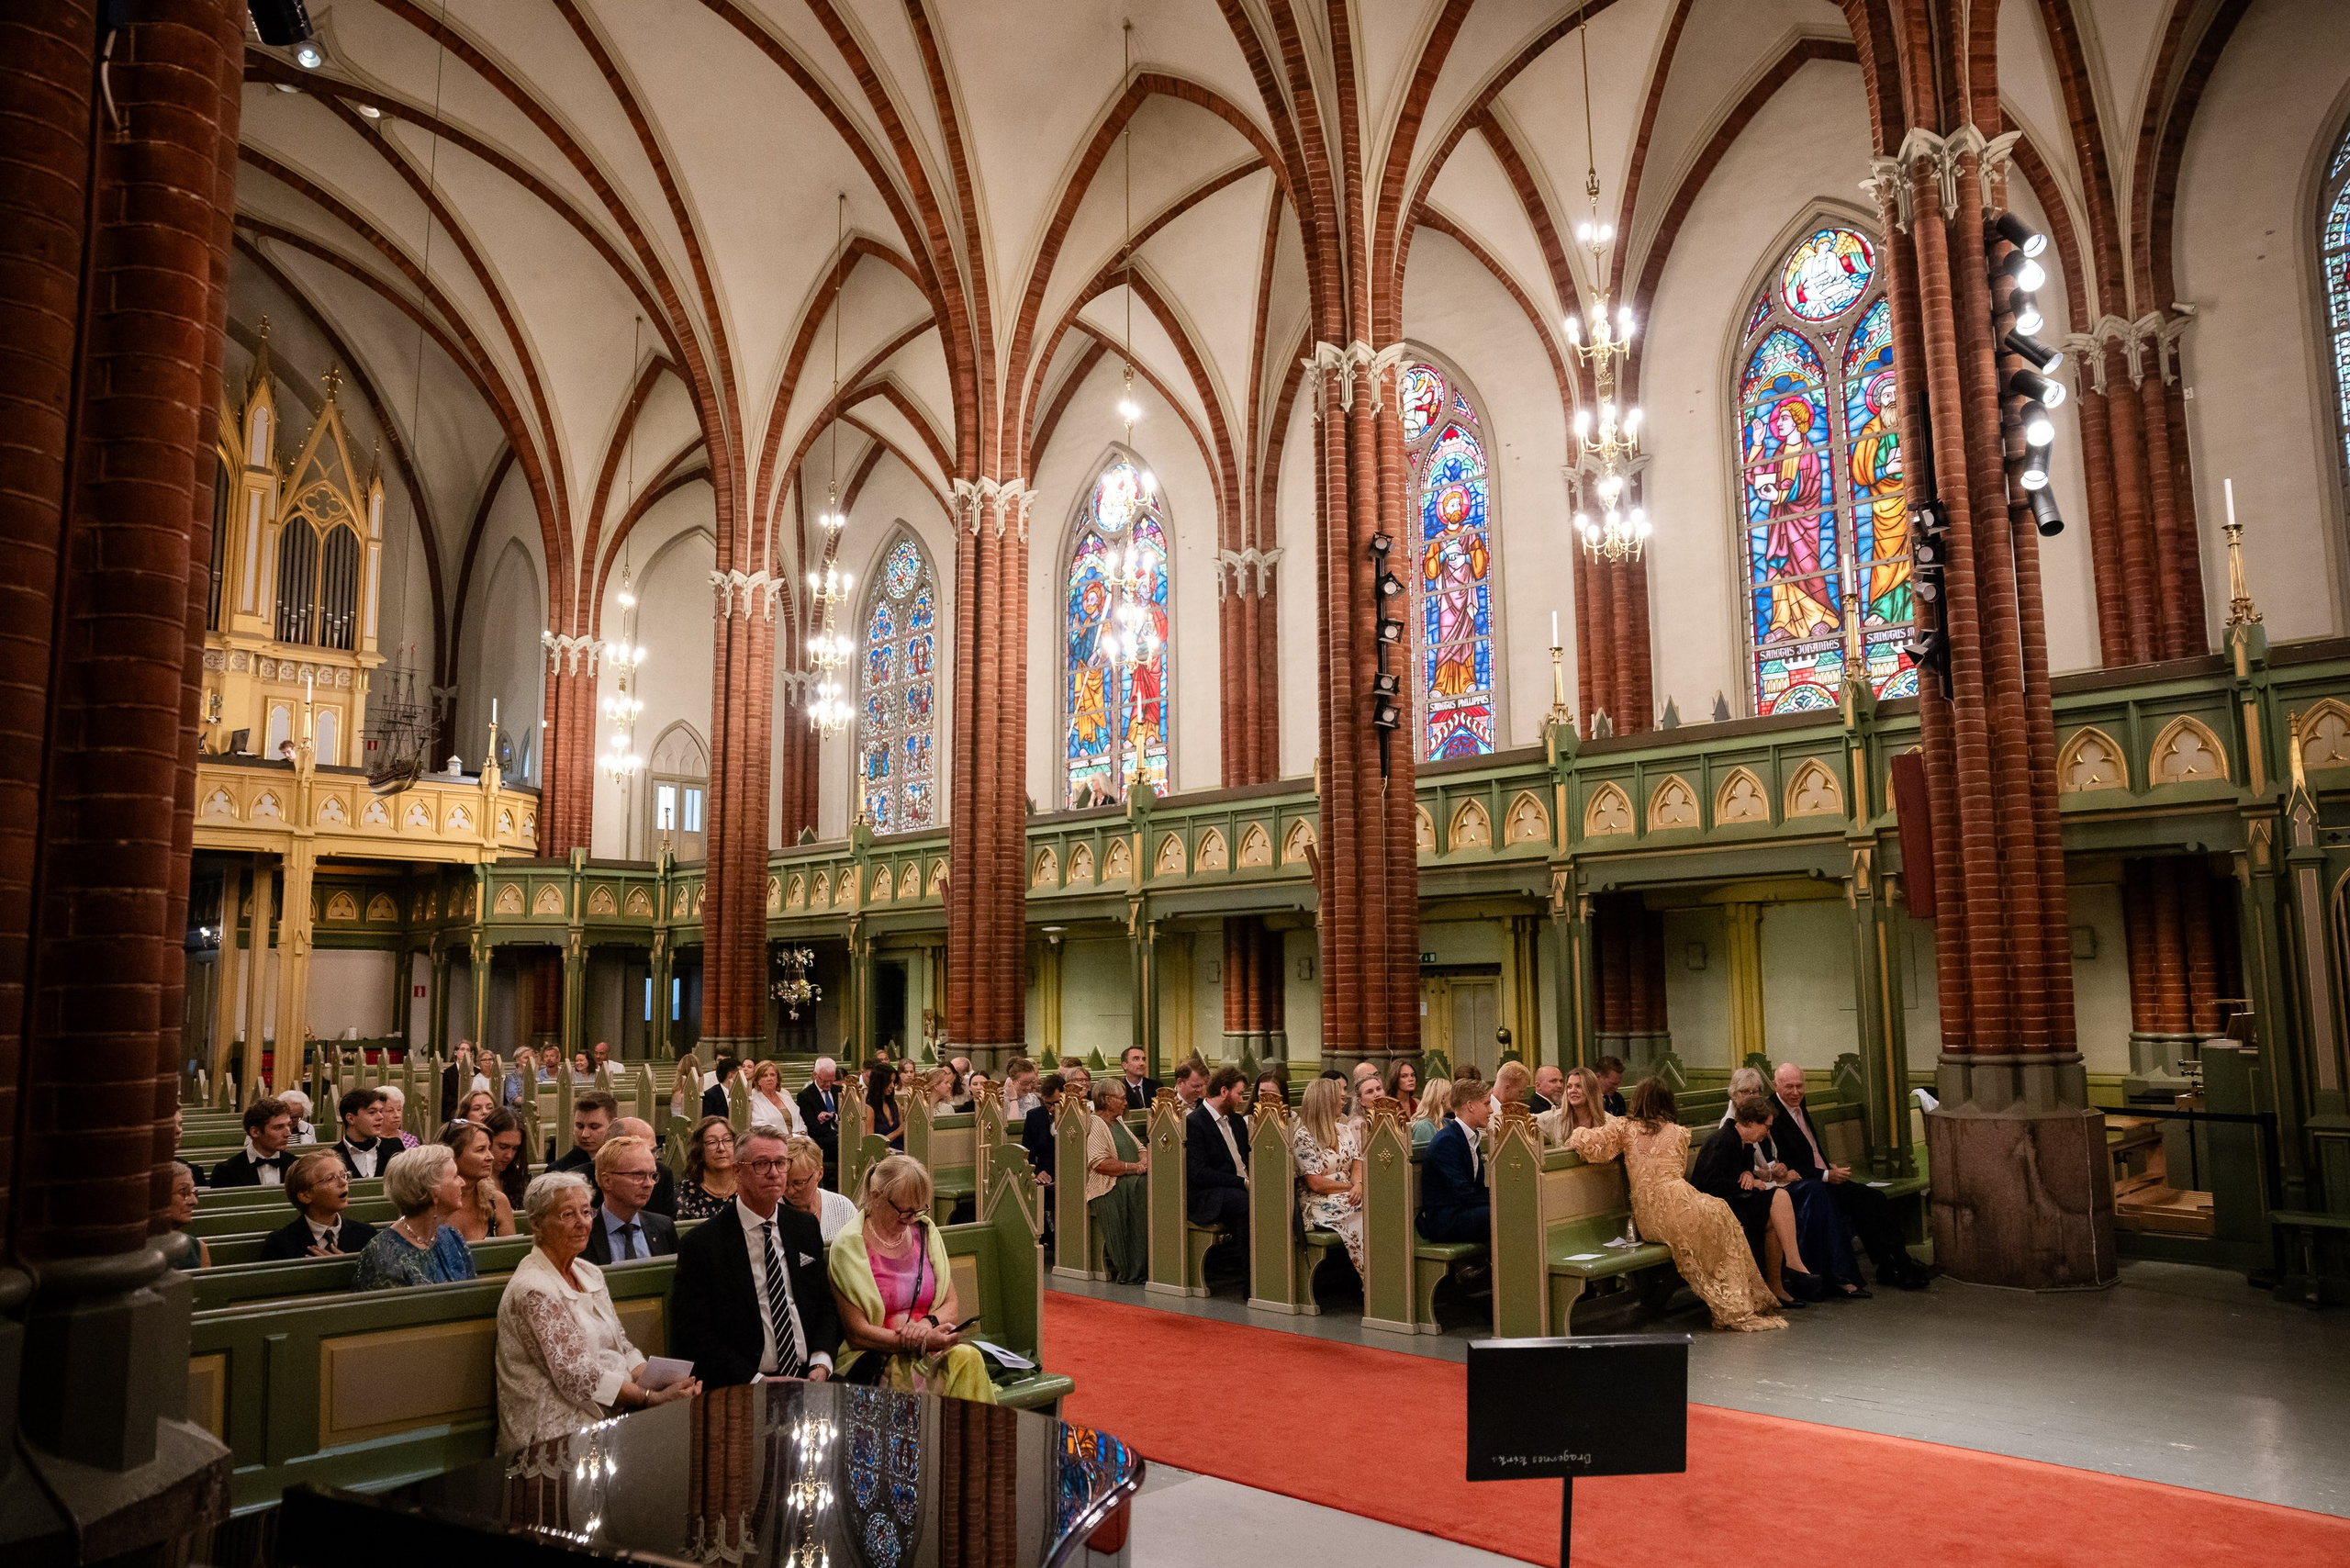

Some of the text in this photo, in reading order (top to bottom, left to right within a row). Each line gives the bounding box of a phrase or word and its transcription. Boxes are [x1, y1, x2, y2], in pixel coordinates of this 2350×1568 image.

[1866, 628, 1906, 644] SANCTUS
[1760, 639, 1840, 661] SANCTUS JOHANNES
